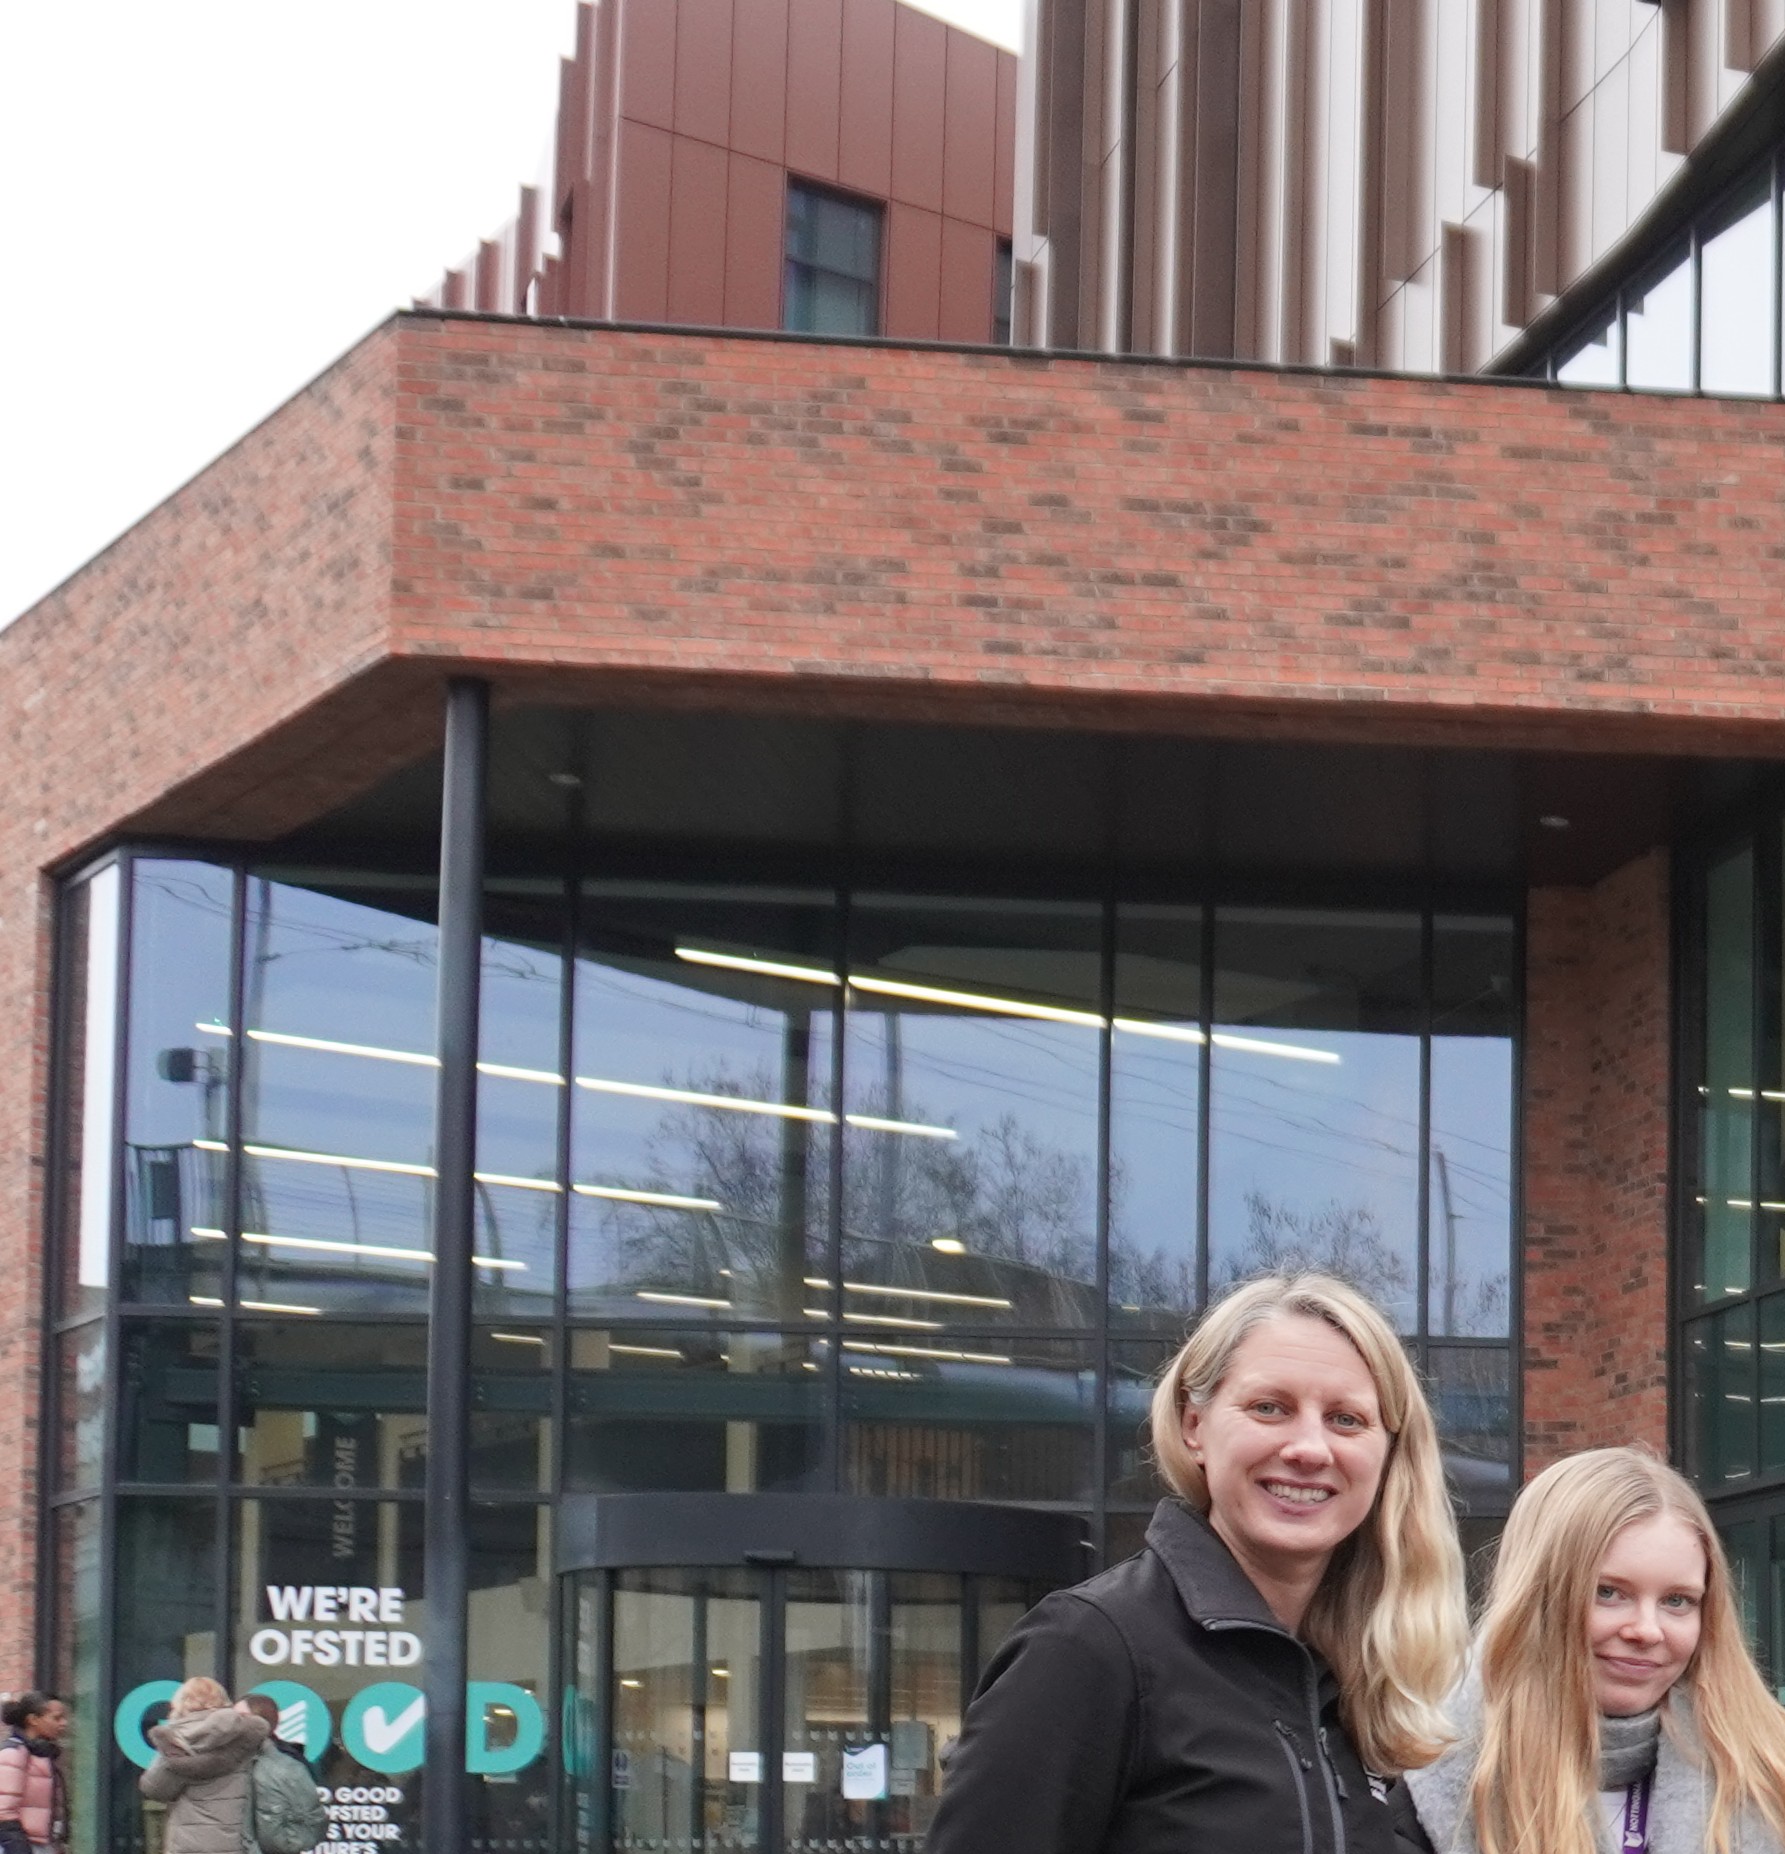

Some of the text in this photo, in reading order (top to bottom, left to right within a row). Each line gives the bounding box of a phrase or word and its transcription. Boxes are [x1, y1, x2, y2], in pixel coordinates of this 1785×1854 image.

[266, 1585, 406, 1623] WE'RE
[250, 1628, 423, 1666] OFSTED
[335, 1786, 404, 1804] GOOD
[343, 1823, 402, 1840] YOUR
